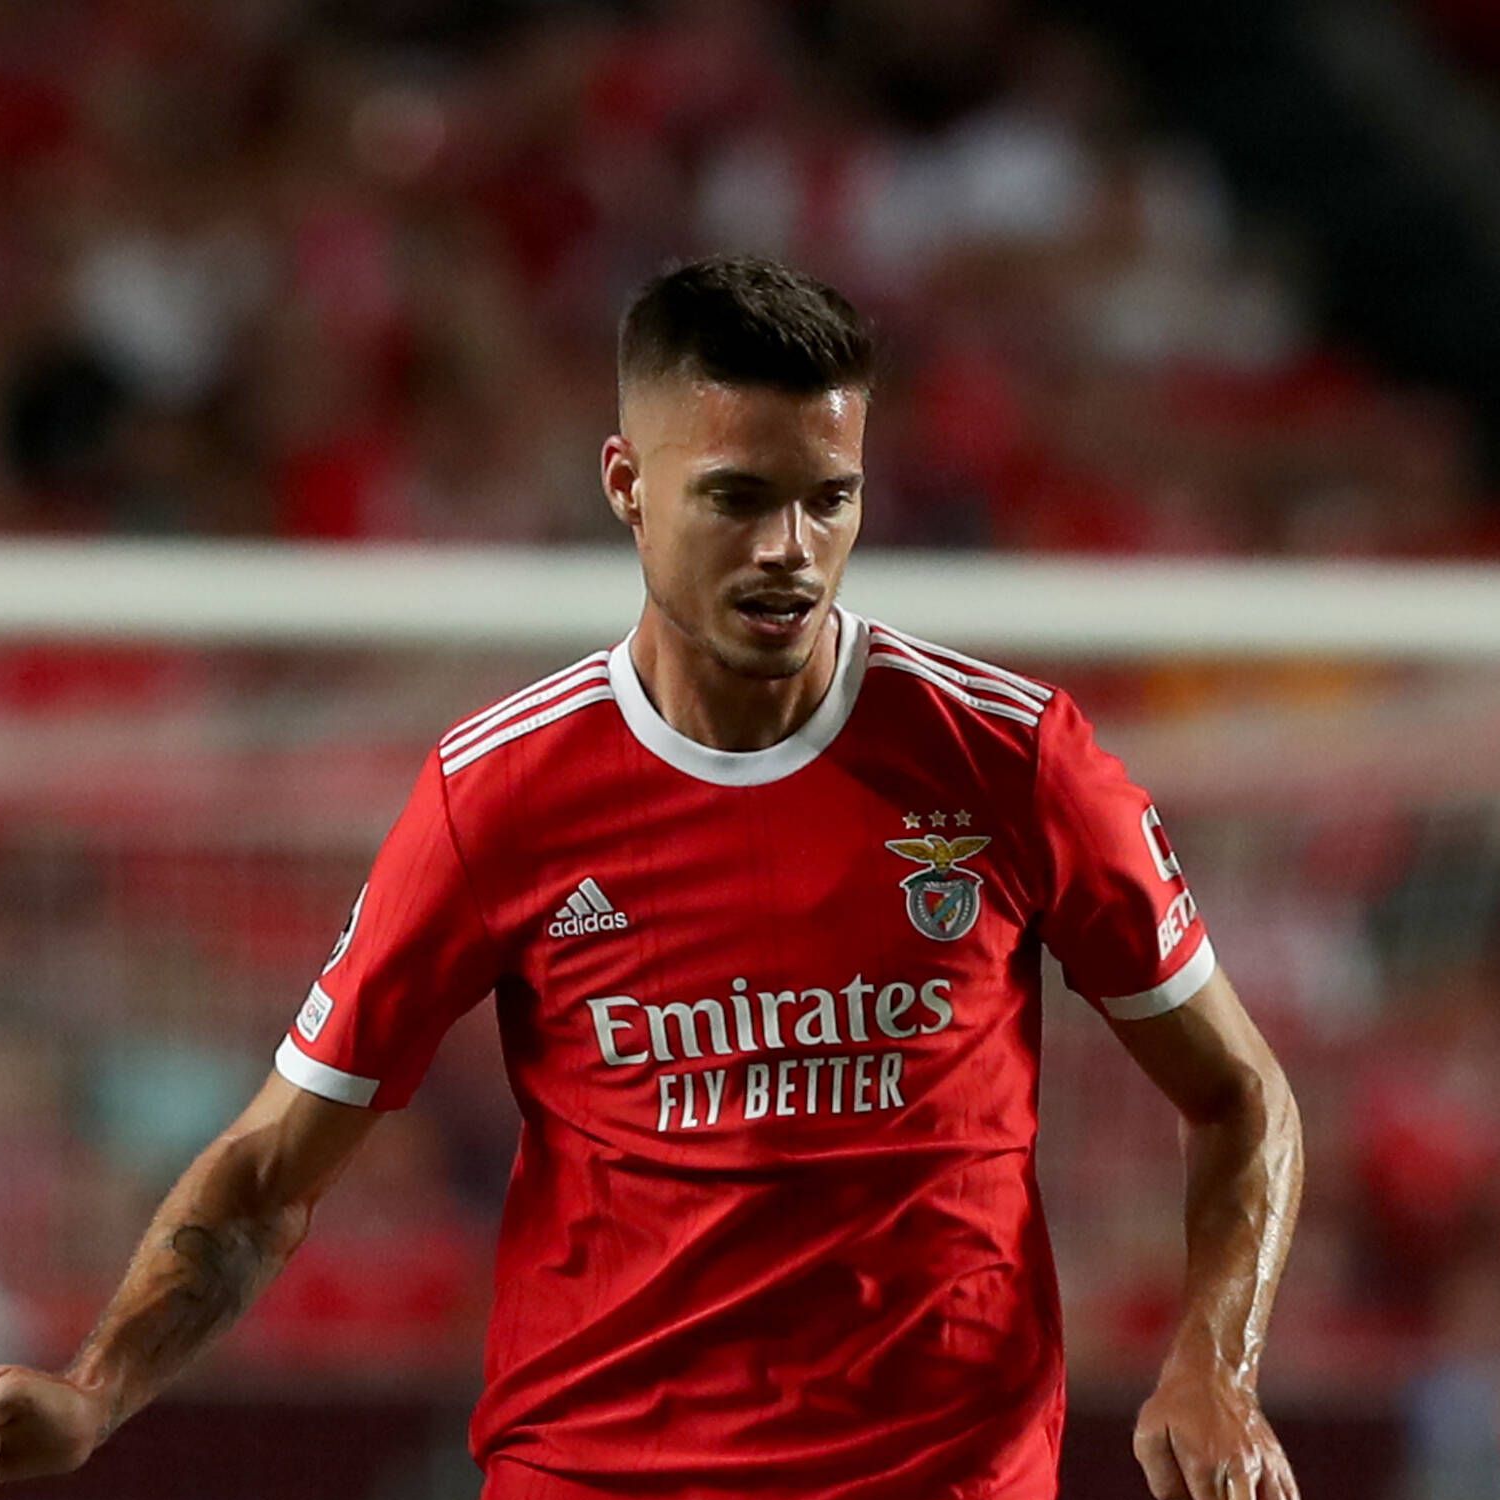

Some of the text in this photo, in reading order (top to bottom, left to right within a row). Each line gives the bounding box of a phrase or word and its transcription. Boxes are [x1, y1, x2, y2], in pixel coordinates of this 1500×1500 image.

[548, 911, 629, 937] adidas
[586, 973, 954, 1066] Emirates
[657, 1052, 905, 1132] FLY BETTER
